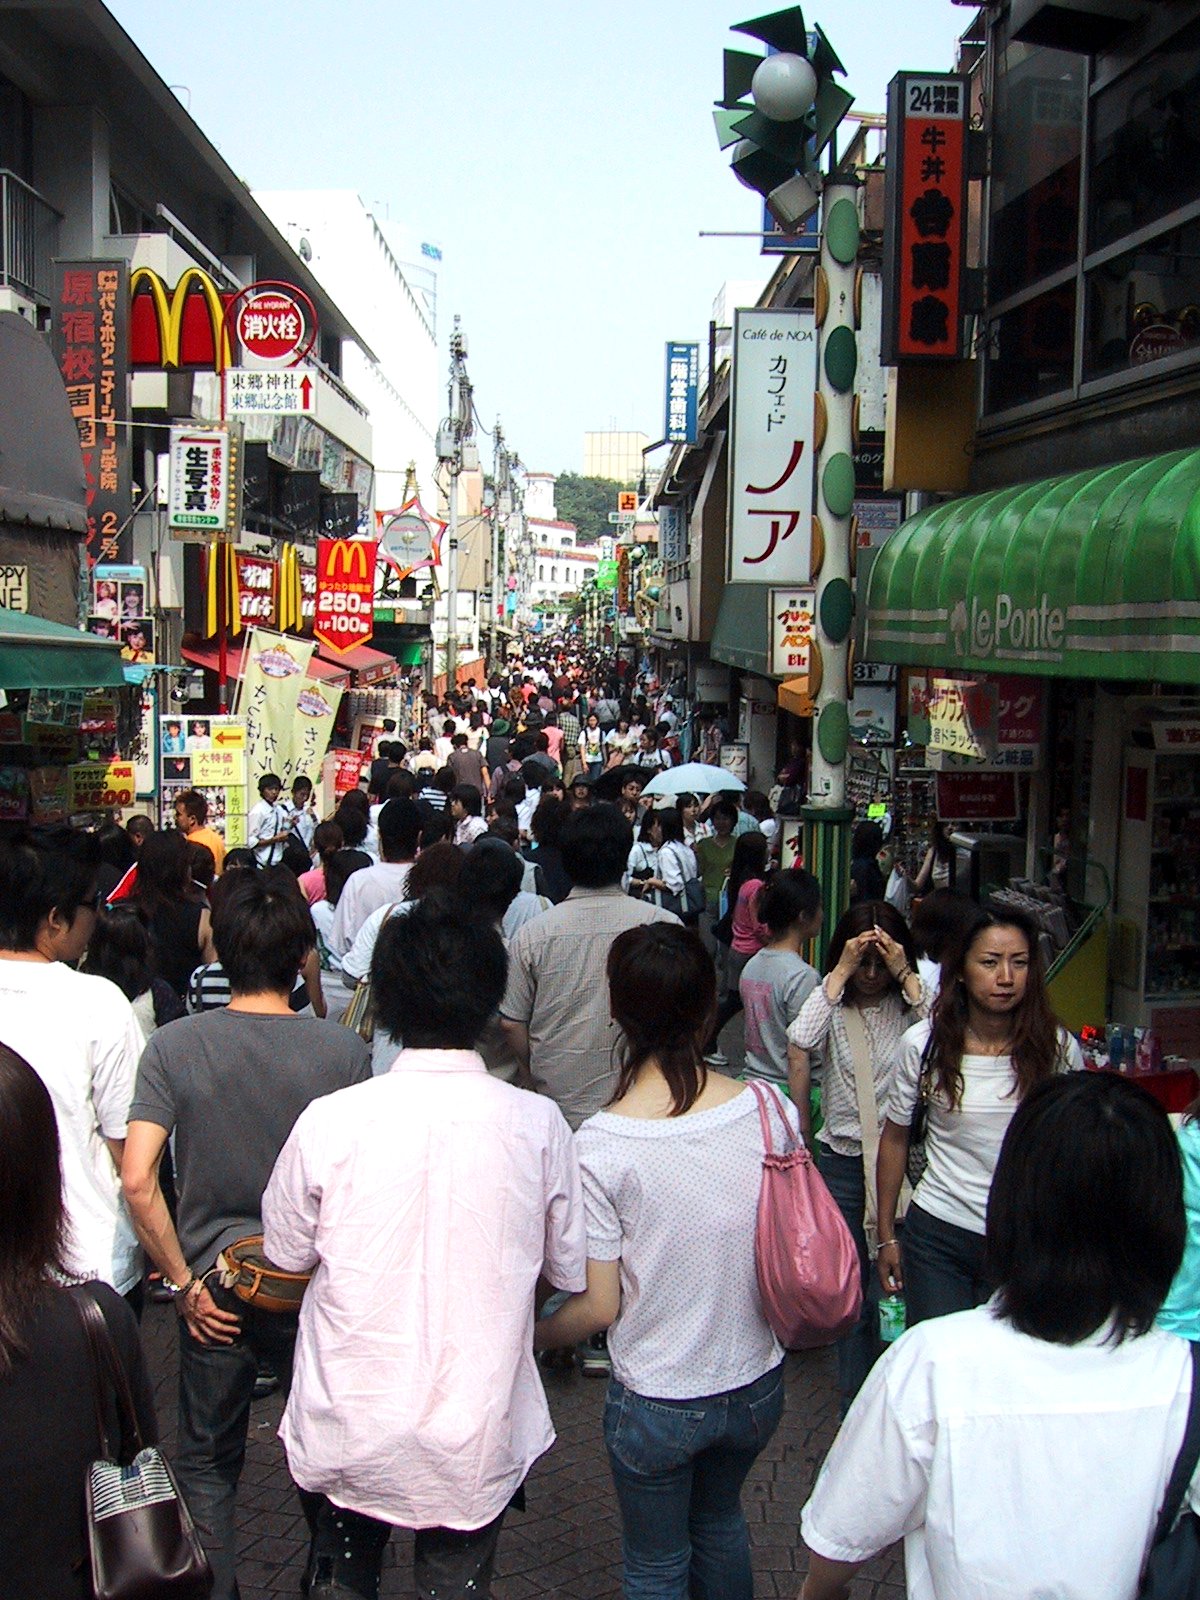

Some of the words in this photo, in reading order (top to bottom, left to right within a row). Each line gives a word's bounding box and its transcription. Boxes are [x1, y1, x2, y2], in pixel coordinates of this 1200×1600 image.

[909, 86, 932, 112] 24
[920, 125, 946, 184] 牛丼
[249, 300, 262, 310] FIRE
[263, 301, 291, 311] HYDRANT
[61, 270, 96, 381] 原宿校
[243, 313, 299, 340] 消火栓
[742, 327, 767, 341] Café
[769, 328, 784, 341] de
[786, 329, 814, 342] NOA
[232, 373, 298, 390] 東郷神社
[231, 392, 298, 410] 東郷記念館
[184, 446, 208, 512] 生写真
[742, 440, 805, 564] ノア
[853, 664, 880, 679] 3F
[199, 752, 233, 763] 大特価
[200, 766, 233, 776] セール
